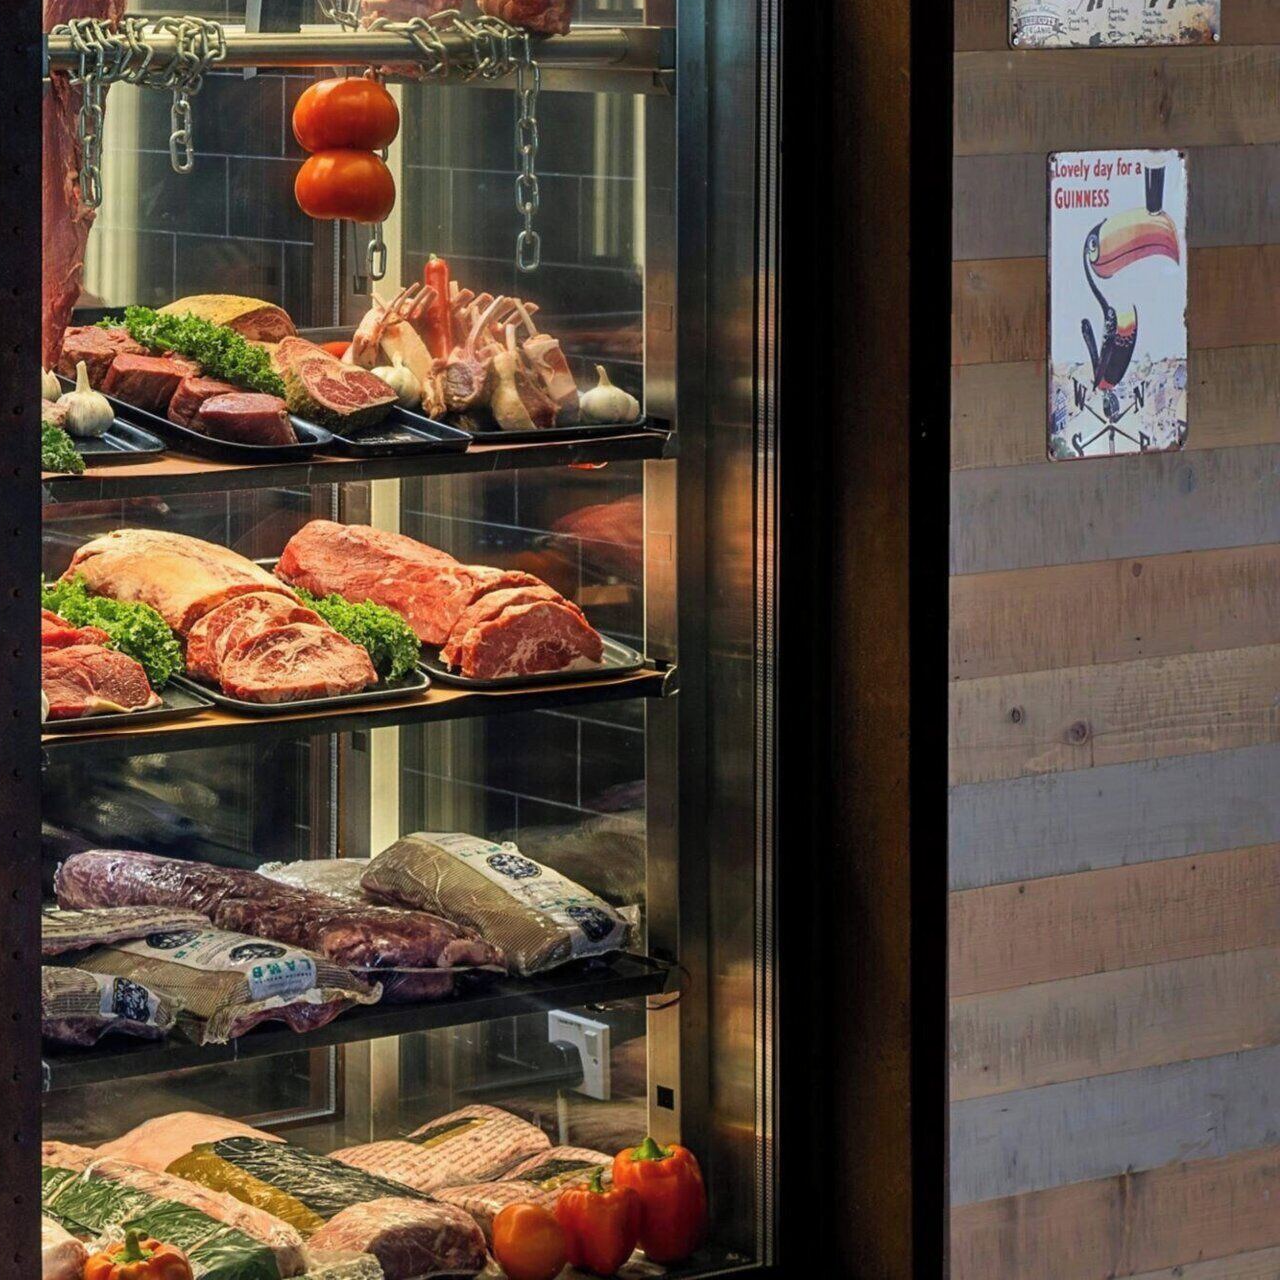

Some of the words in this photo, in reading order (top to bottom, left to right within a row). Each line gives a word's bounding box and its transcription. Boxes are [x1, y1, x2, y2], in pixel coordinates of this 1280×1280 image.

[1055, 158, 1090, 181] Lovely
[1094, 158, 1113, 180] day
[1117, 157, 1132, 176] for
[1135, 162, 1142, 175] a
[1054, 187, 1110, 209] GUINNESS
[252, 958, 312, 979] LAMB
